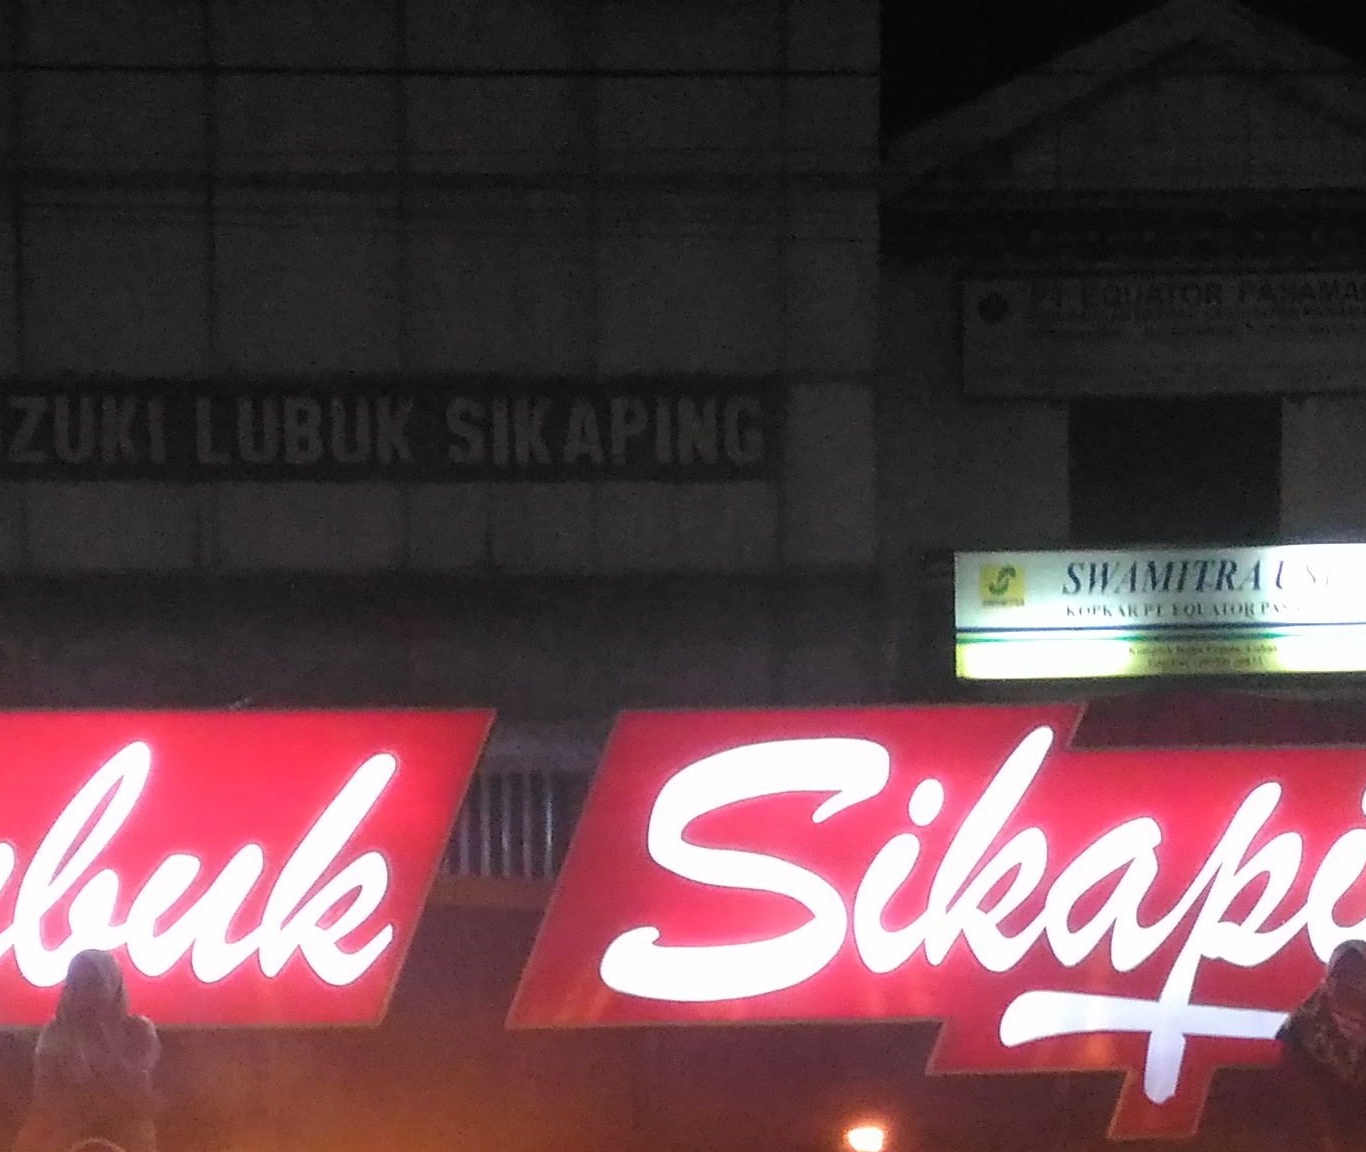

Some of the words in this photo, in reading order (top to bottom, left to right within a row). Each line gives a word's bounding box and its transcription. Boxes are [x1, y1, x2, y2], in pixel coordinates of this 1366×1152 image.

[1081, 280, 1224, 308] EQUATOR
[194, 394, 415, 466] LUBUK
[444, 394, 766, 466] SIKAPING
[1062, 558, 1262, 596] SWAMITRA
[1065, 602, 1140, 619] KOPKAR
[1171, 600, 1256, 619] EQUATOR
